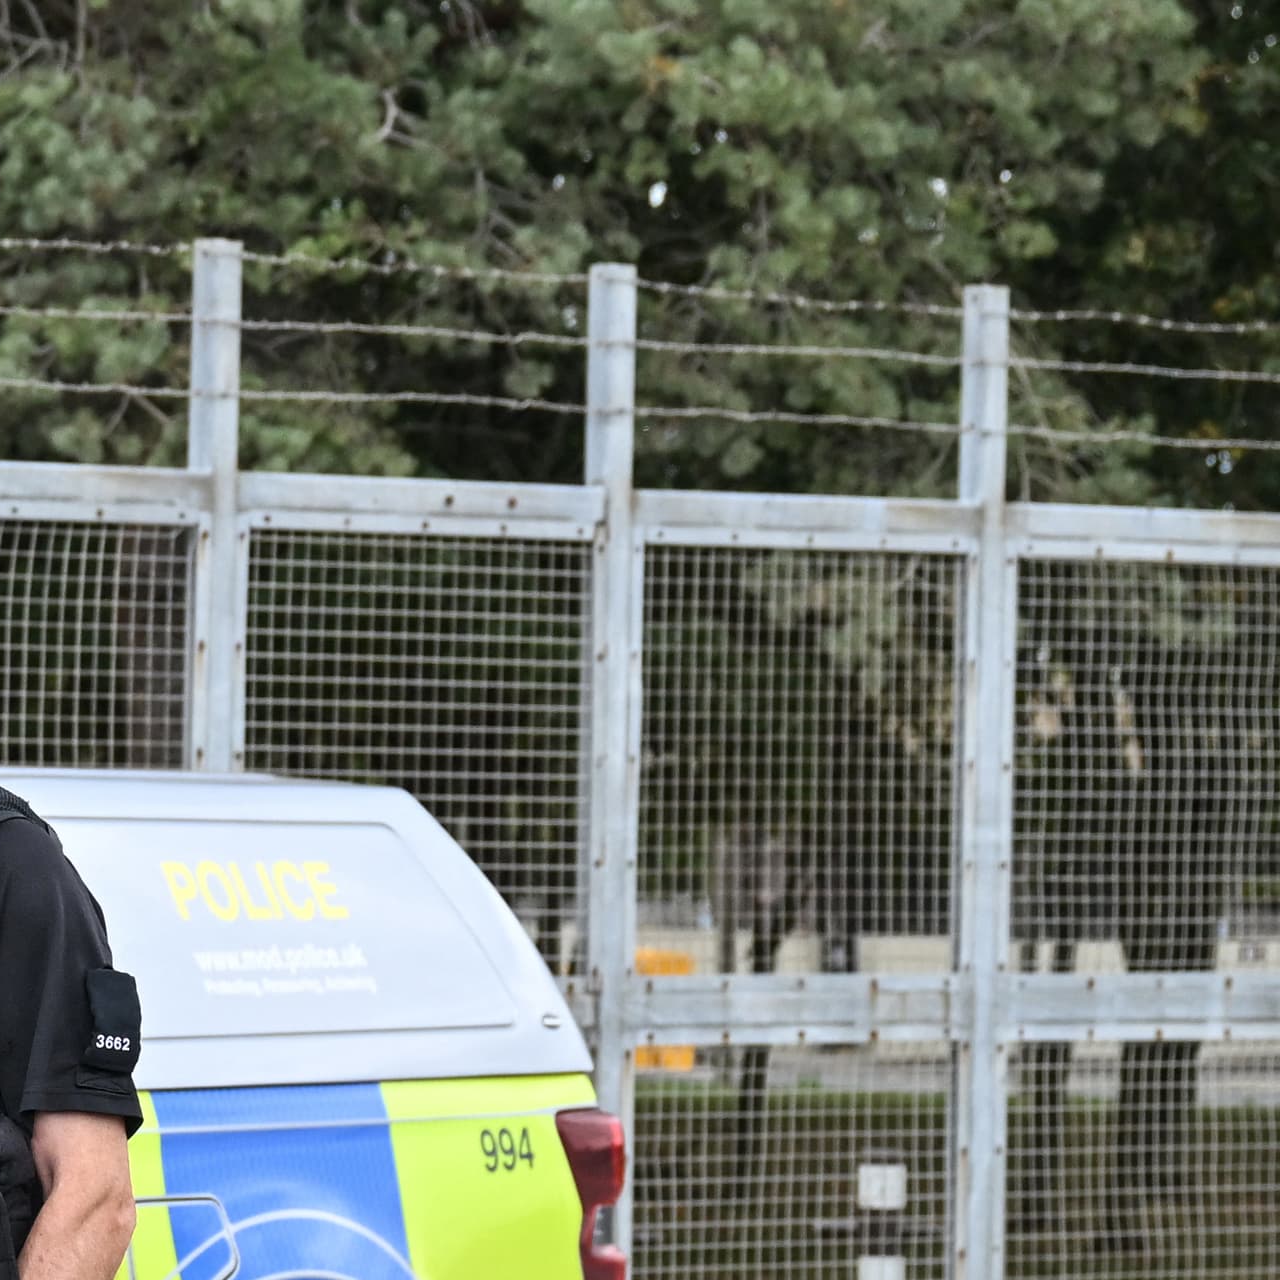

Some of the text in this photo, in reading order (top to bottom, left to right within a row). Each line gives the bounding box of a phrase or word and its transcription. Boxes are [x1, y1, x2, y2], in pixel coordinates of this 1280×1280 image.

[160, 860, 350, 921] POLICE
[95, 1034, 131, 1052] 3662
[480, 1127, 534, 1172] 994
